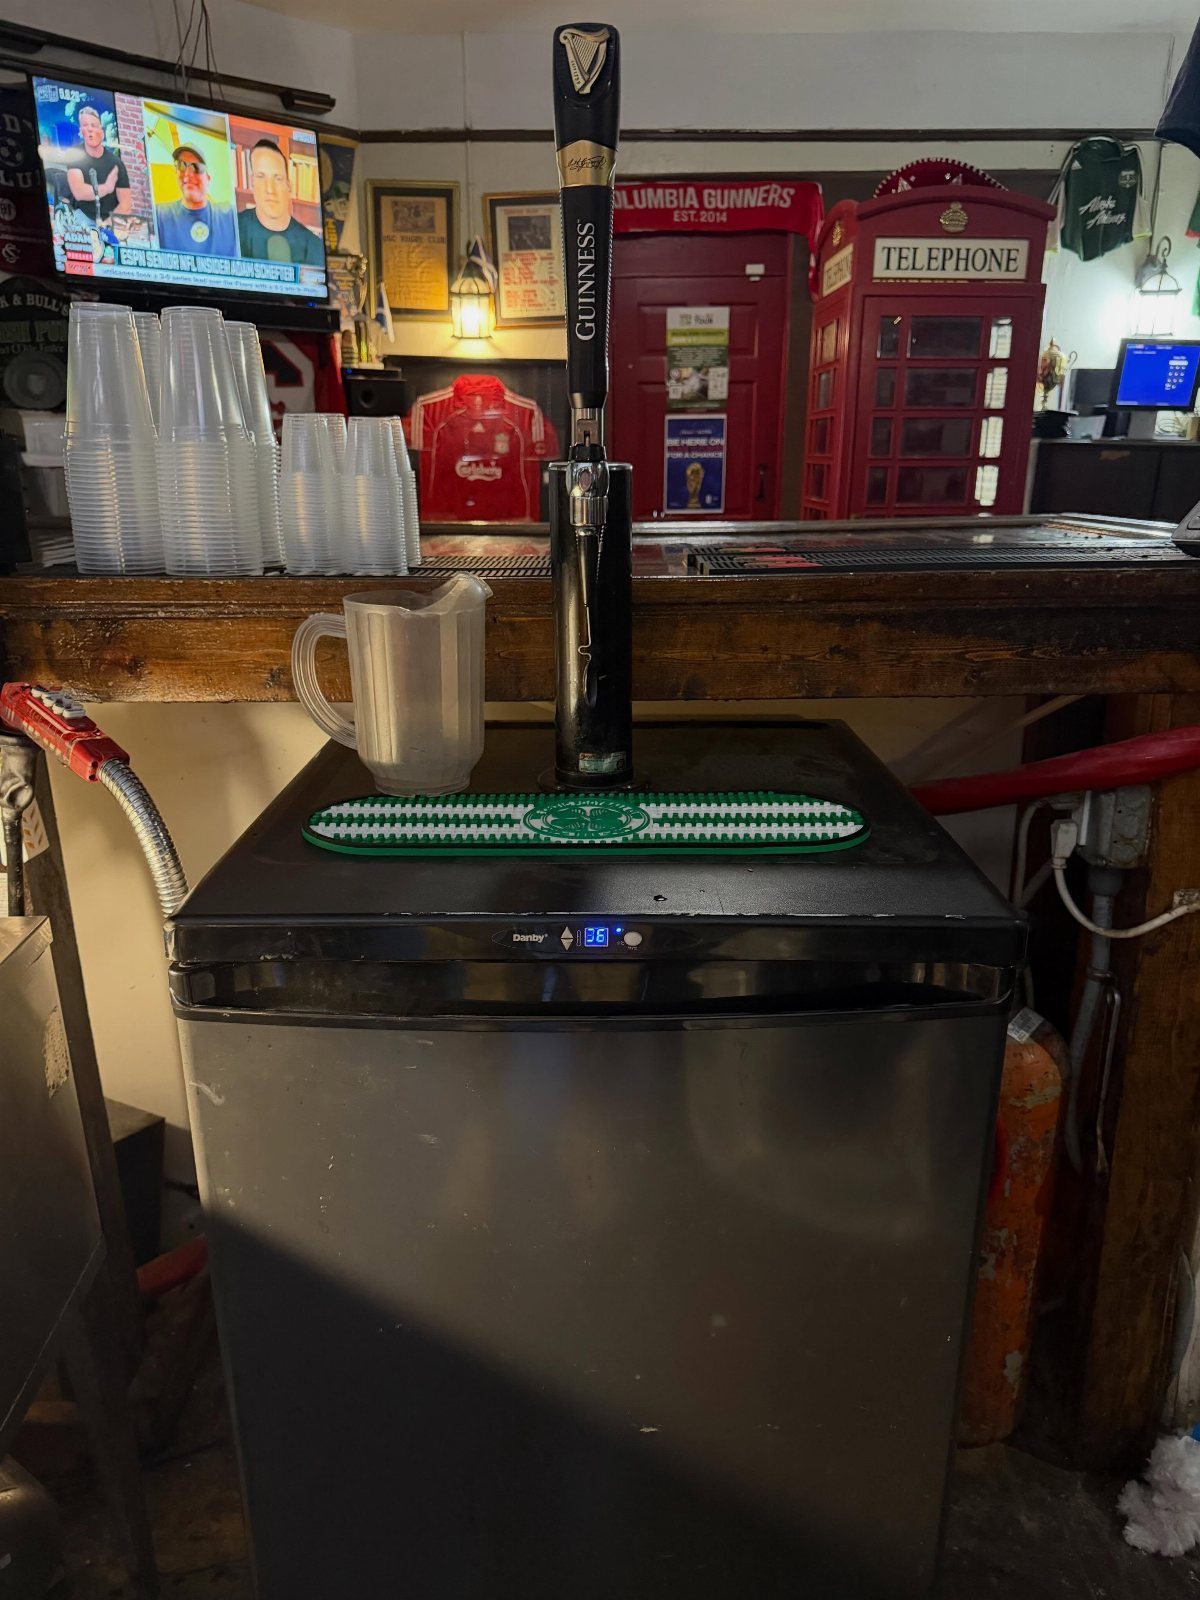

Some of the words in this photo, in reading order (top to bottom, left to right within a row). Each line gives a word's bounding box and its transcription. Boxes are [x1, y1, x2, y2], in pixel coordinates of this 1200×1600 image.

[613, 187, 699, 209] OLUMBIA
[703, 184, 795, 209] GUNNERS
[673, 210, 699, 222] EST.
[700, 211, 728, 223] 2014
[120, 249, 146, 267] ESPN
[146, 251, 180, 271] SENIOR
[179, 254, 197, 272] NFL
[197, 256, 230, 276] INSIDER
[230, 259, 254, 278] ADAM
[254, 262, 295, 282] SCHEFTER
[882, 246, 1020, 272] TELEPHONE
[575, 223, 596, 341] GUINNESS
[26, 292, 70, 317] BULL'S
[681, 438, 708, 447] HERE
[455, 458, 503, 481] Carlsberg
[512, 933, 545, 943] Danby
[586, 928, 605, 943] 36
